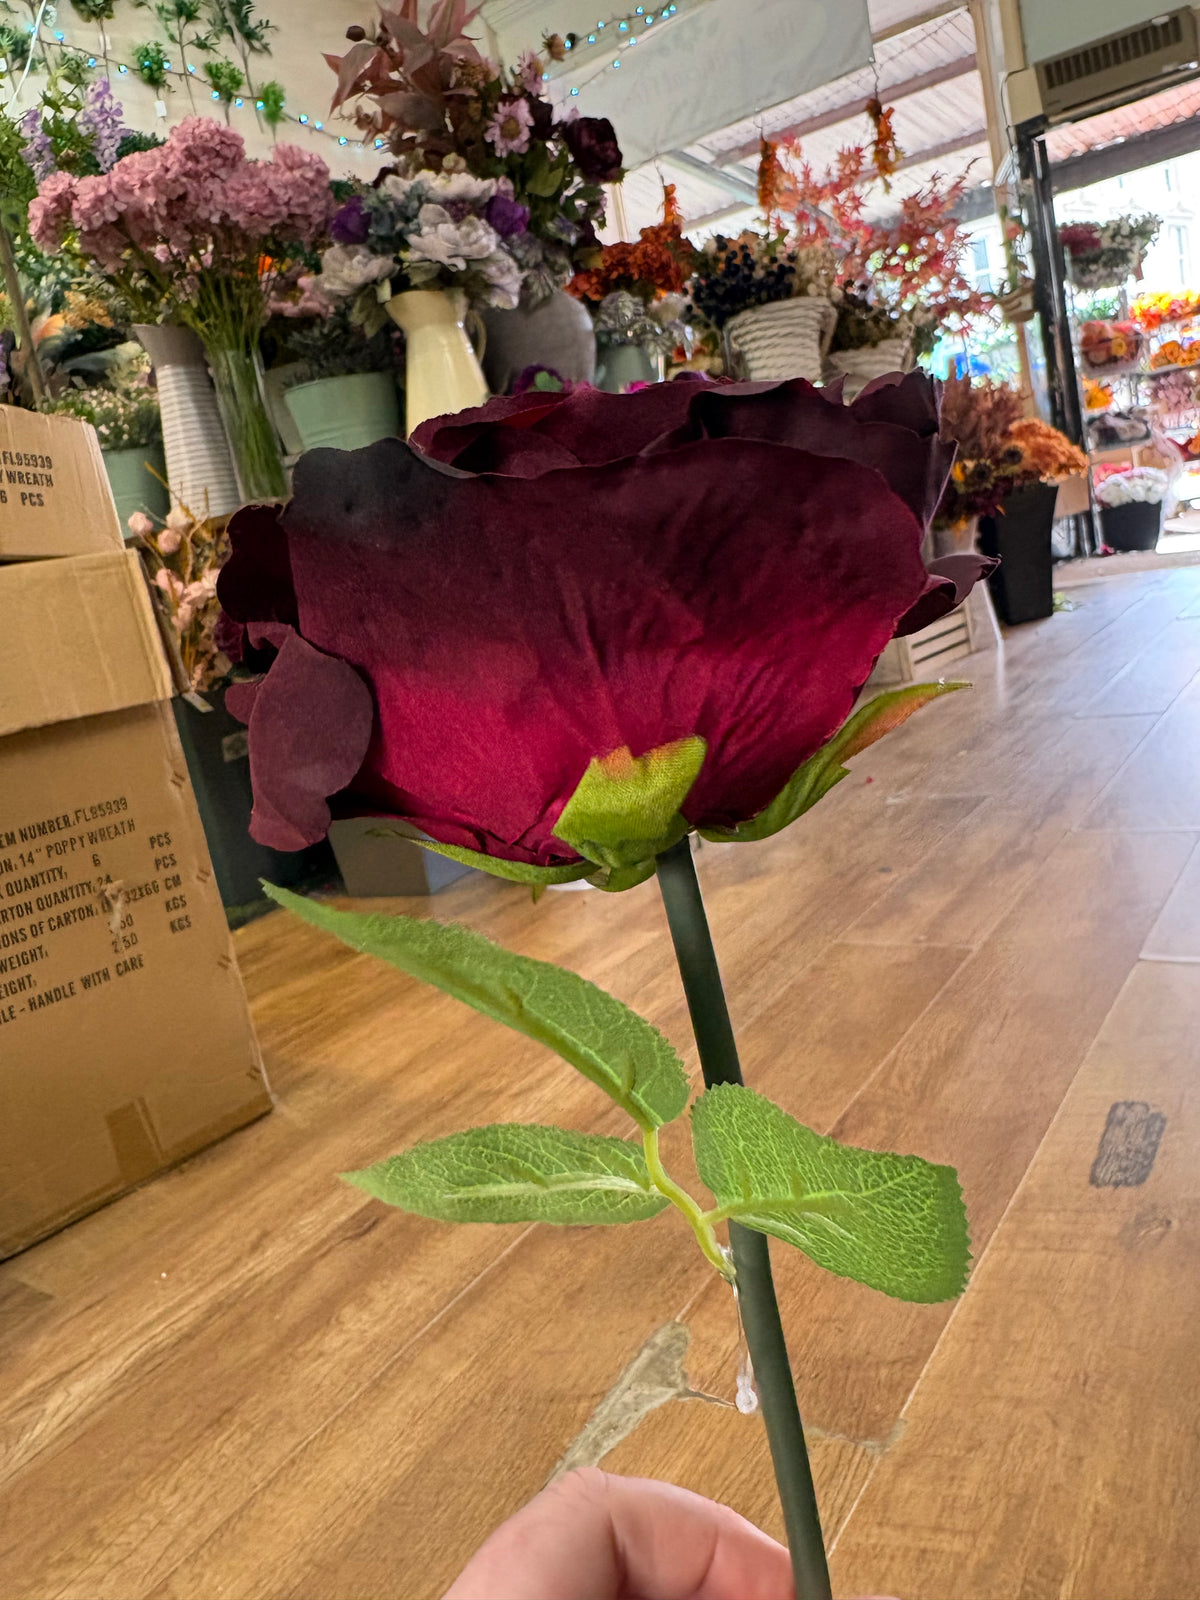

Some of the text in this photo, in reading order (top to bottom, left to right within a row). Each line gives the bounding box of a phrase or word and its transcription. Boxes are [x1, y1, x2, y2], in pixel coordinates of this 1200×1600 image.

[6, 469, 54, 488] WREATH
[20, 491, 45, 507] PCS
[45, 835, 85, 859] POPPY
[87, 818, 136, 845] WREATH
[92, 853, 101, 867] 6
[149, 832, 172, 850] PCS
[154, 853, 177, 871] PCS
[30, 921, 45, 940] OF
[164, 874, 182, 891] CM
[165, 895, 188, 912] KGS
[169, 915, 192, 934] KGS
[28, 981, 77, 1012] HANDLE
[80, 967, 111, 990] WITH
[116, 953, 145, 977] CARE
